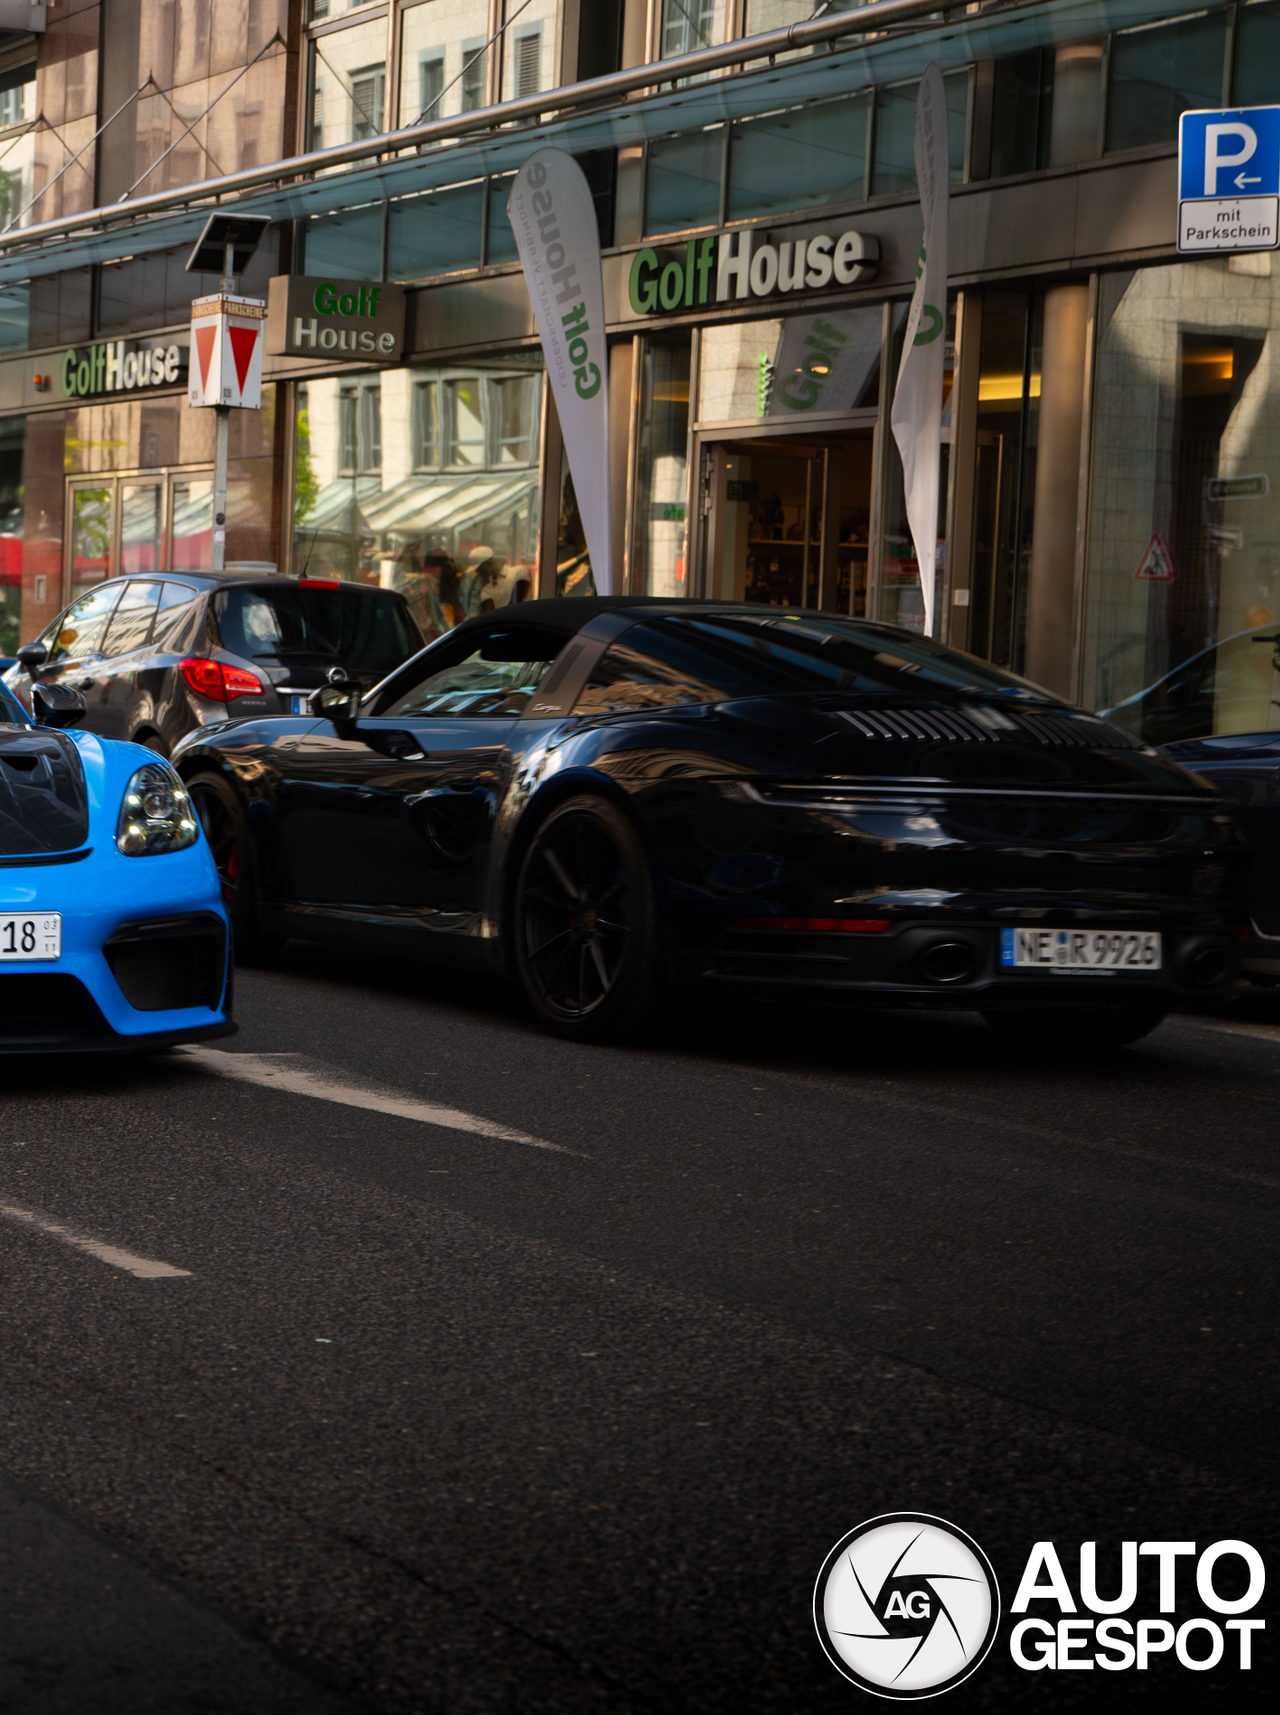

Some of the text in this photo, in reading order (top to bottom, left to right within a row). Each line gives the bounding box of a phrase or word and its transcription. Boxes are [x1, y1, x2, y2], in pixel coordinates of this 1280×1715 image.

[1204, 122, 1258, 196] P
[1186, 222, 1271, 241] Parkschein
[1216, 208, 1242, 223] mit
[628, 229, 870, 315] GolfHouse
[224, 301, 264, 319] PARKSCHEINE
[313, 283, 380, 318] Golf
[293, 317, 396, 355] House
[62, 340, 180, 397] GolfHouse
[1016, 931, 1161, 966] NE R 9926
